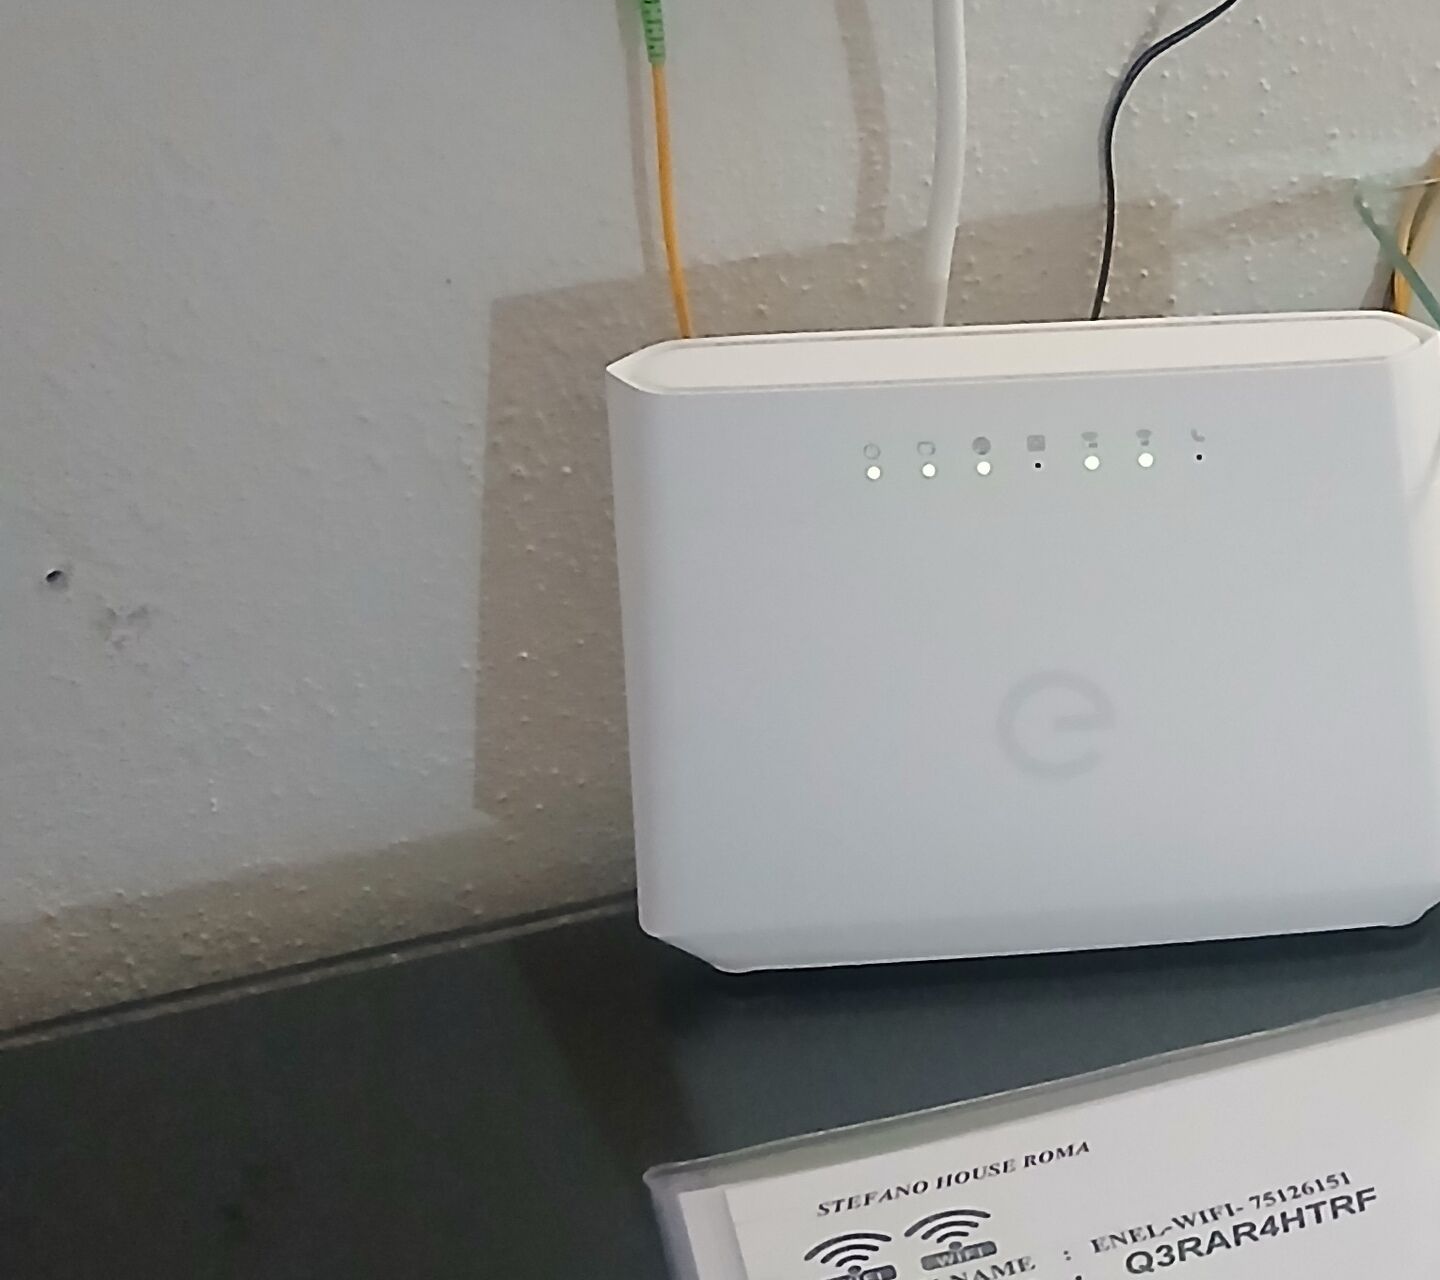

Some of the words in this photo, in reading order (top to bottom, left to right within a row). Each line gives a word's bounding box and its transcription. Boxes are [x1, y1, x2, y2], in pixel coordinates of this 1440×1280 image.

[817, 1179, 929, 1217] STEFANO
[936, 1158, 1016, 1192] HOUSE
[1023, 1140, 1091, 1170] ROMA
[1091, 1202, 1244, 1253] ENEL-WIFI-
[1249, 1171, 1352, 1212] 75126151
[1125, 1187, 1378, 1277] Q3RAR4HTRF
